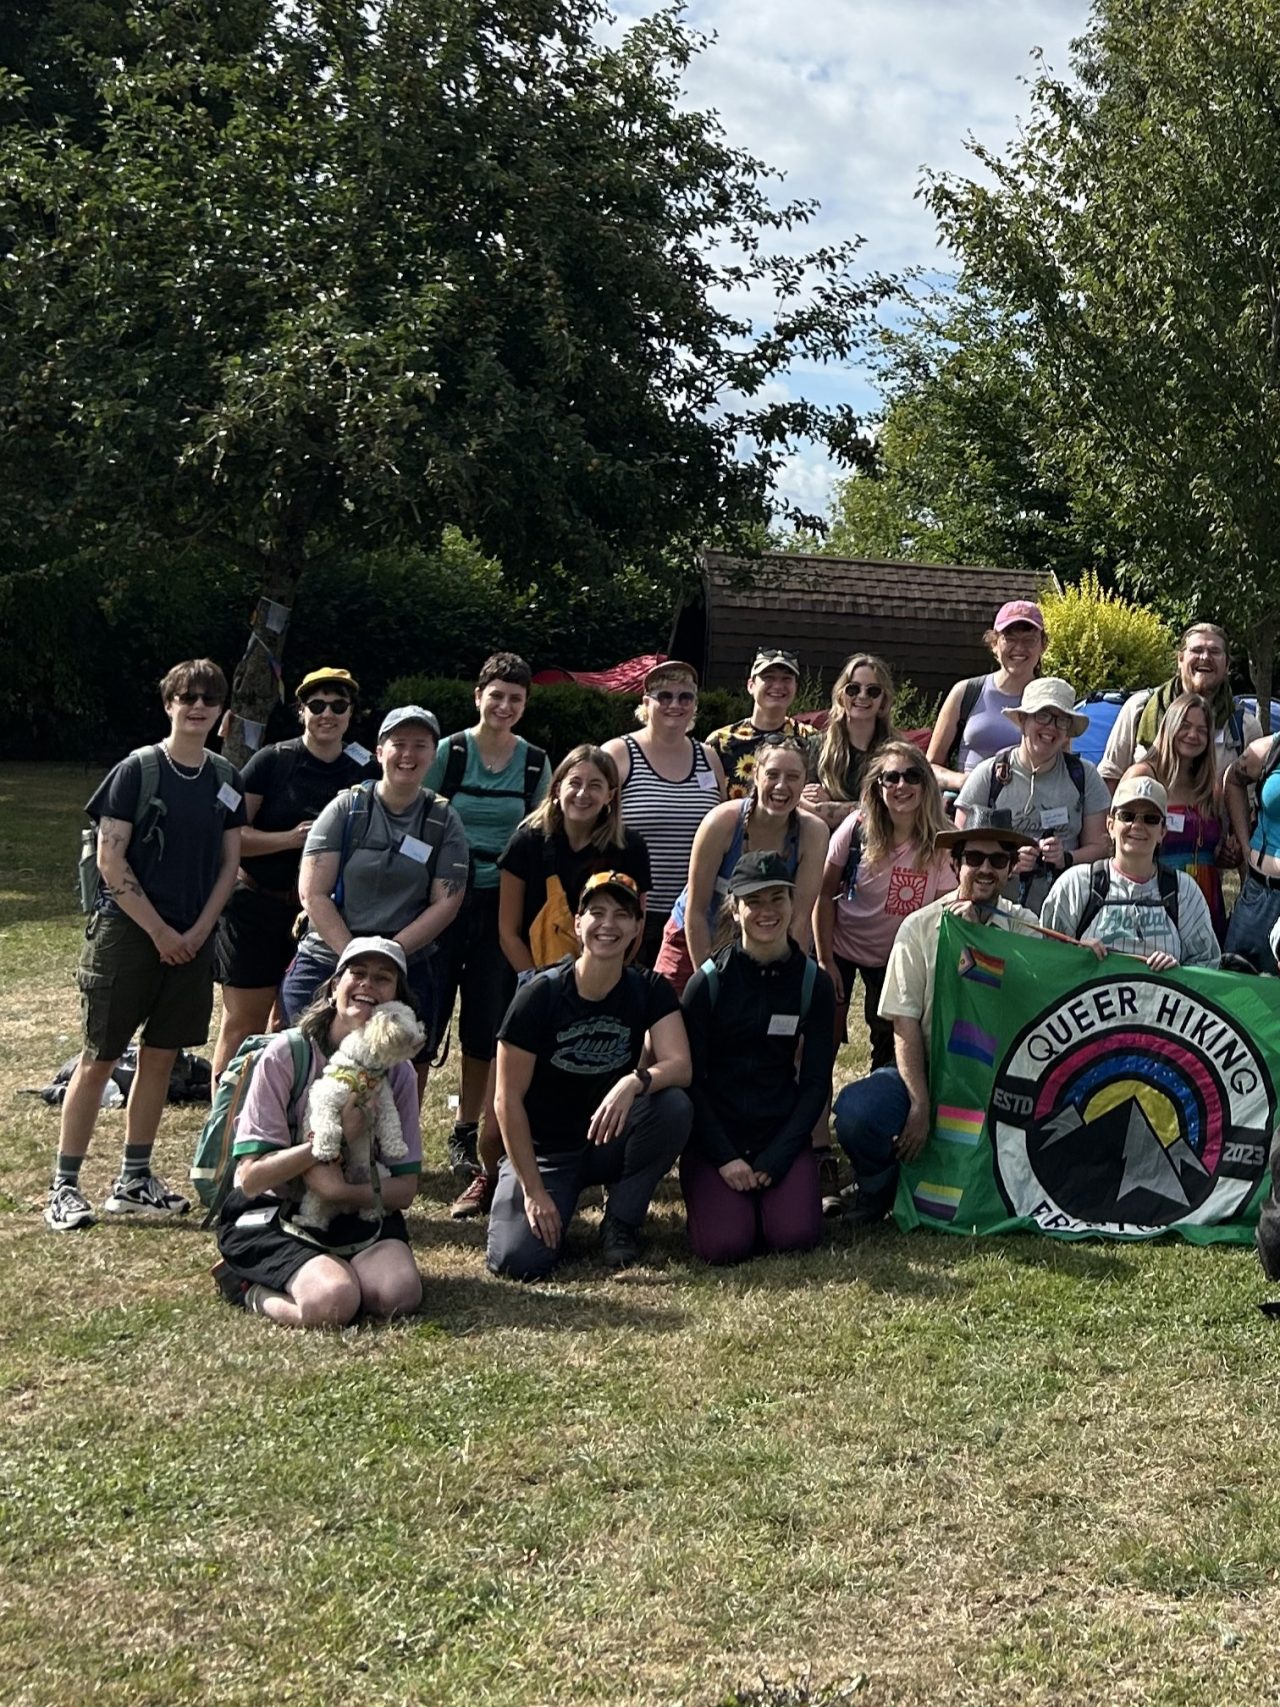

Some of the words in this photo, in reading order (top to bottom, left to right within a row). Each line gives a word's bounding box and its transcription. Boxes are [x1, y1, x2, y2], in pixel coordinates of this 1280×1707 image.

[1028, 986, 1138, 1061] QUEER
[1156, 994, 1257, 1095] HIKING
[993, 1087, 1034, 1115] ESTD
[1222, 1141, 1265, 1166] 2023
